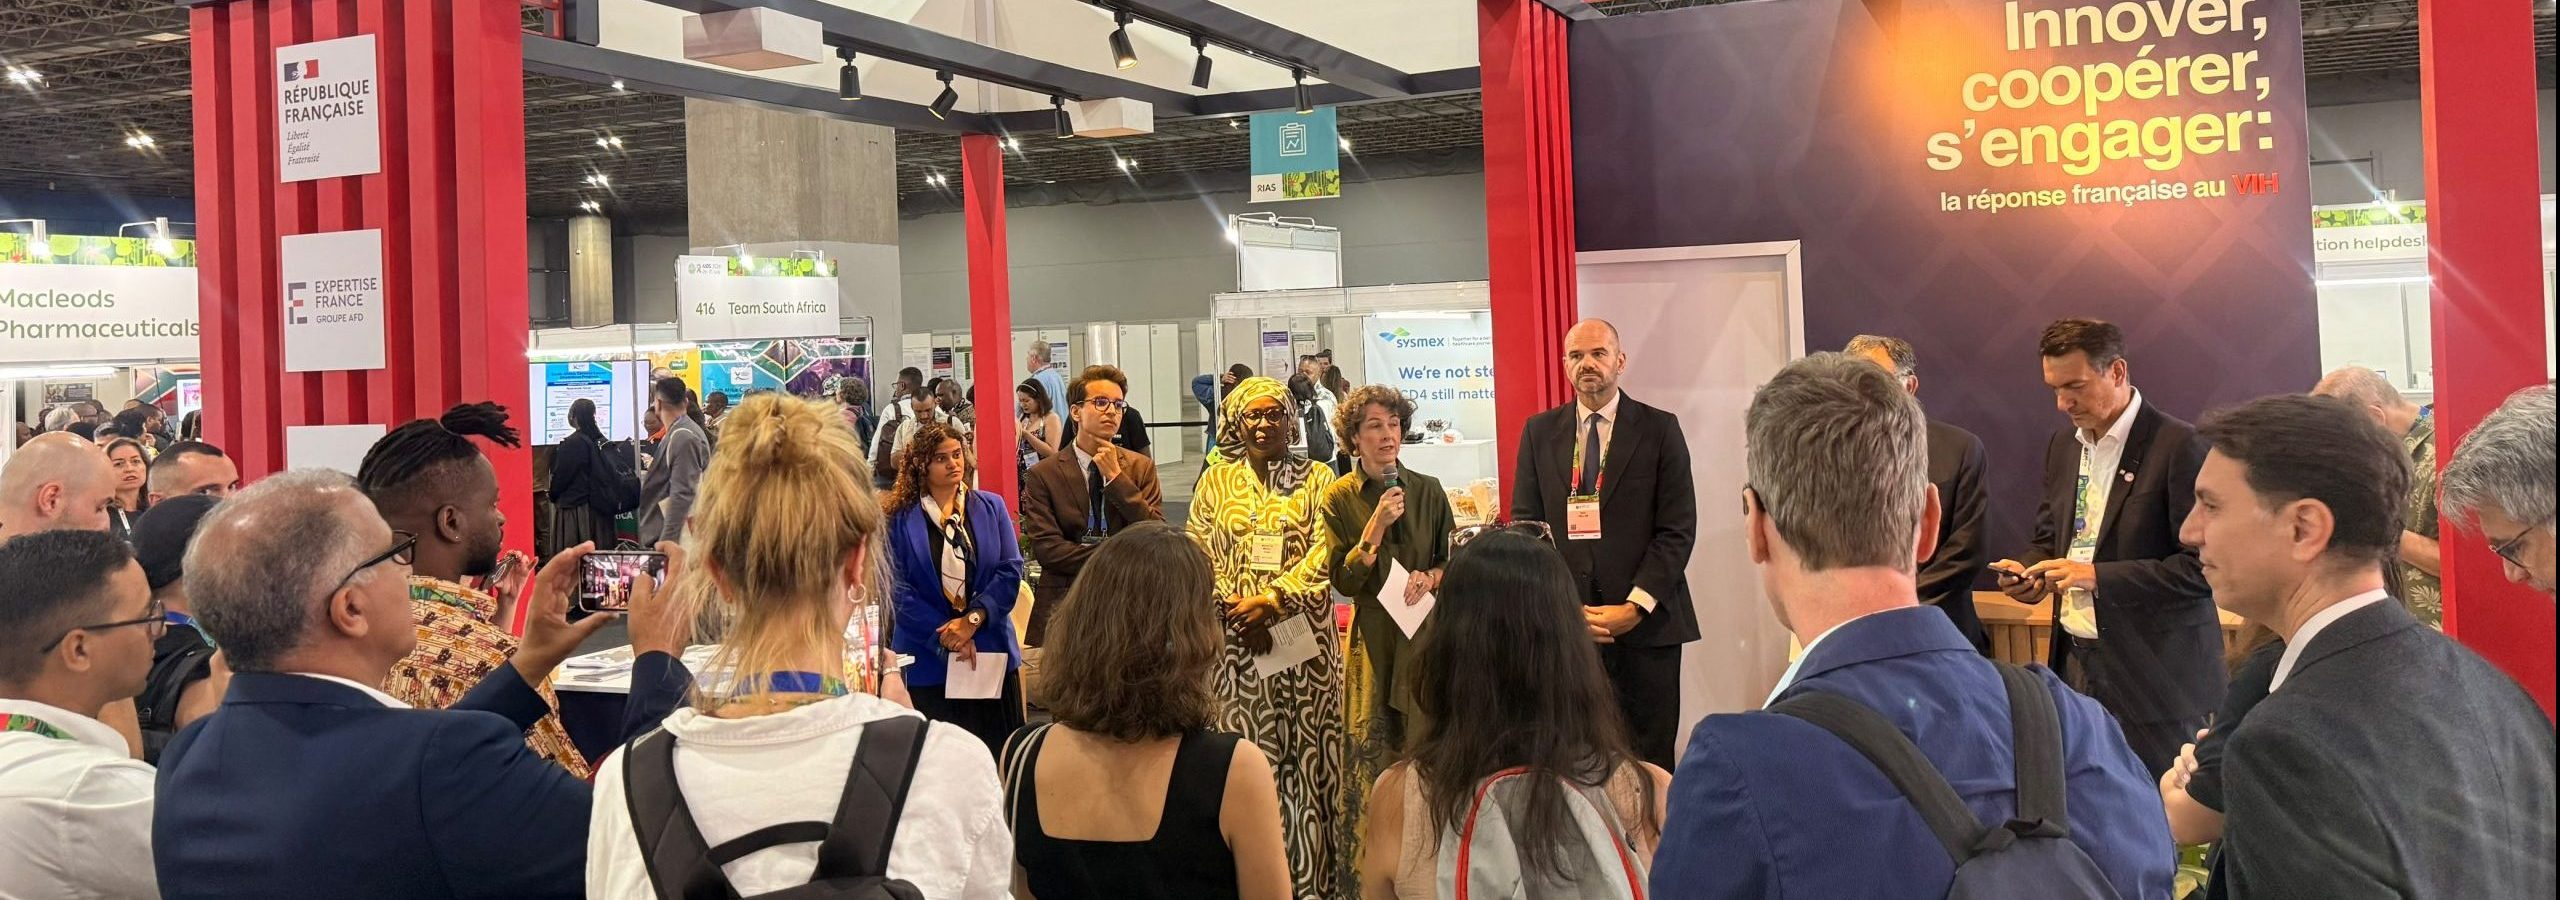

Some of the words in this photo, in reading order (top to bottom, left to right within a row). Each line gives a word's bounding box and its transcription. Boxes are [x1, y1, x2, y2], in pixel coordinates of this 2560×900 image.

[2005, 0, 2267, 50] Innover,
[1962, 44, 2270, 117] coopérer,
[284, 79, 370, 105] RÉPUBLIQUE
[285, 100, 364, 124] FRANÇAISE
[287, 129, 309, 141] Liberté
[287, 141, 311, 154] Égalité
[288, 152, 320, 165] Fraternité
[1941, 192, 1961, 212] la
[1967, 187, 2067, 214] réponse
[2072, 179, 2188, 207] française
[2193, 177, 2226, 198] au
[2232, 172, 2280, 195] VIH
[315, 278, 377, 293] EXPERTISE
[0, 288, 115, 309] Macleods
[315, 293, 364, 308] FRANCE
[695, 302, 715, 316] 416
[728, 301, 760, 315] Team
[763, 301, 795, 314] South
[797, 299, 826, 314] Africa
[316, 314, 347, 323] GROUPE
[348, 313, 364, 322] AFD
[1396, 336, 1445, 348] sysmex
[1445, 366, 1471, 378] not
[1432, 388, 1454, 400] still
